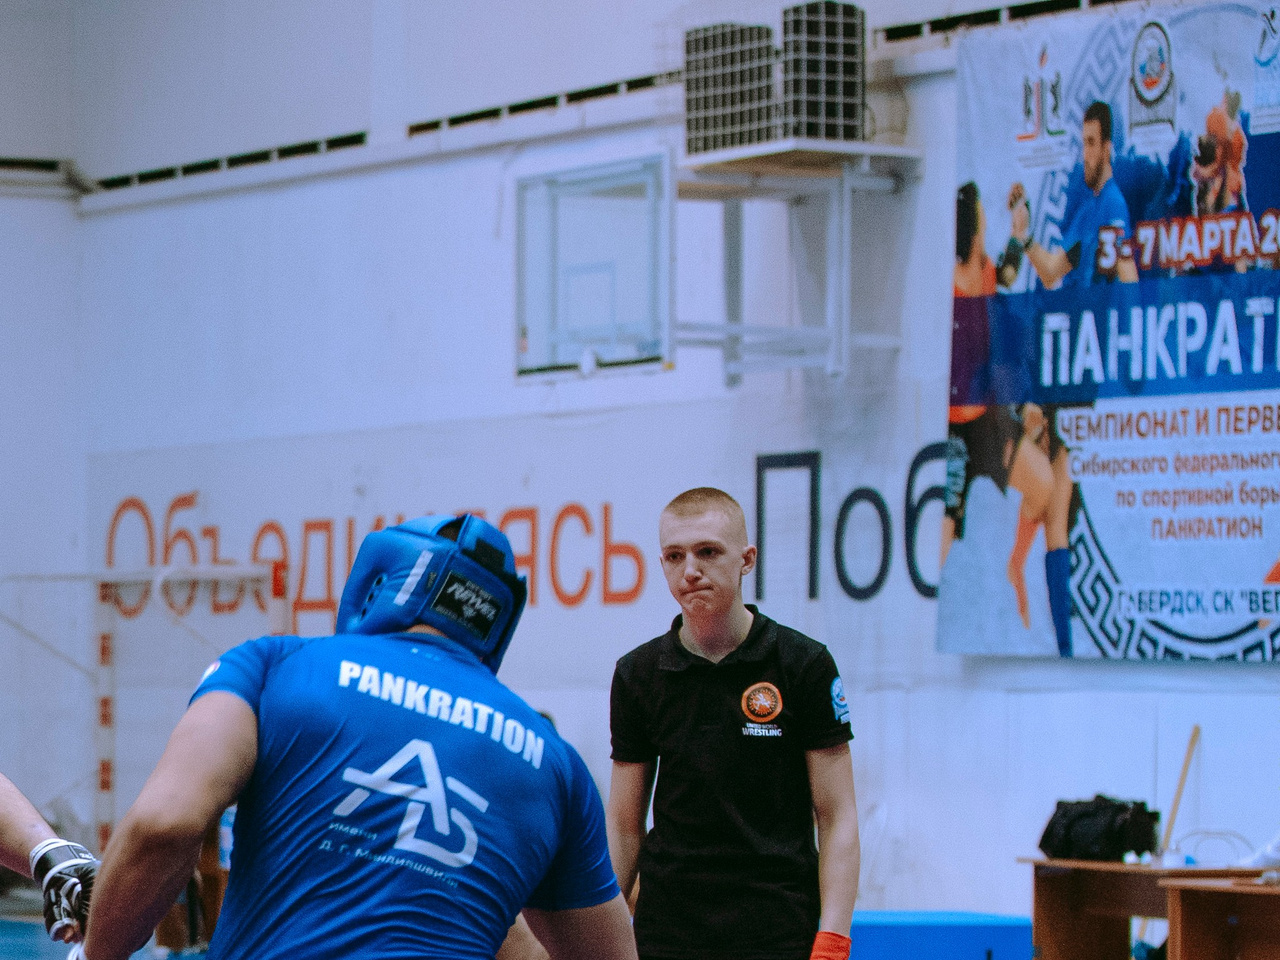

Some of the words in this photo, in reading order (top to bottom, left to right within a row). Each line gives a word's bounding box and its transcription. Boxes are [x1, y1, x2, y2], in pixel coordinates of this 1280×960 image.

[1158, 218, 1256, 263] МАРТА
[1040, 297, 1280, 387] ПАНКРАТ
[1061, 408, 1190, 441] ЧЕМПИОНАТ
[1195, 406, 1210, 435] И
[1071, 453, 1169, 479] Сибирского
[1116, 490, 1136, 508] по
[1151, 516, 1263, 539] ПАНКРАТИОН
[1213, 590, 1234, 614] СК
[338, 659, 545, 770] PANKRATION
[742, 727, 782, 737] WRESTLING
